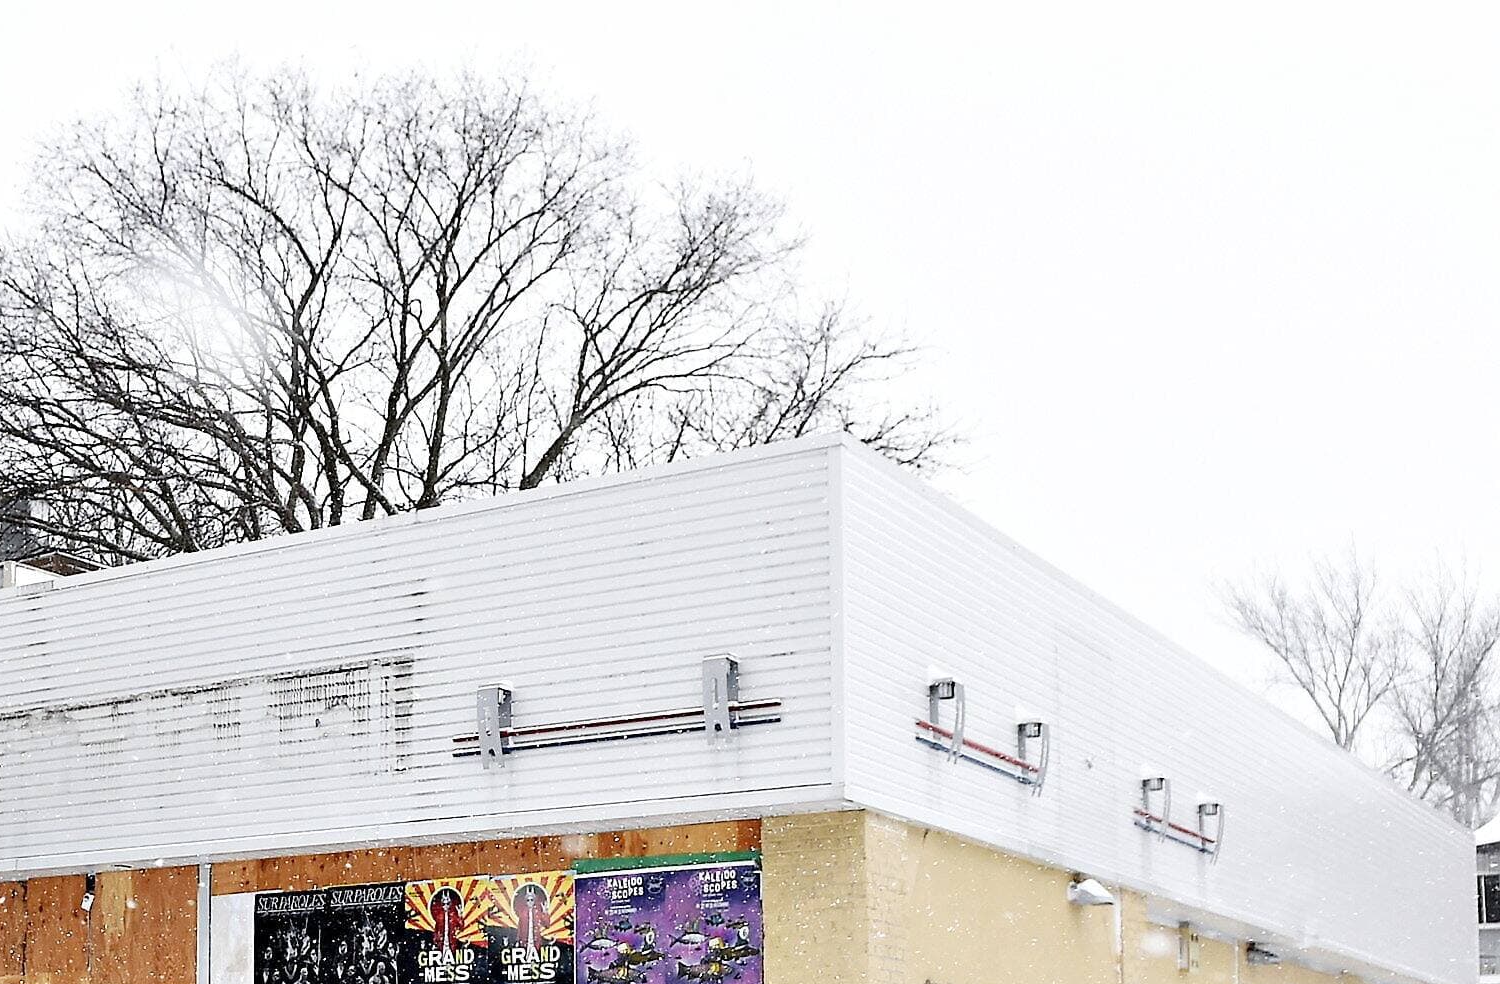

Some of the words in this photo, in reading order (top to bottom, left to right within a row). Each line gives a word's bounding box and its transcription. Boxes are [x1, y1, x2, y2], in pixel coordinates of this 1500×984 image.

[607, 876, 643, 890] KALEIDO
[698, 869, 737, 883] KALEIDO
[703, 879, 738, 893] SCOPES
[611, 887, 644, 900] SCOPES
[418, 949, 475, 967] GRAND
[501, 946, 561, 964] GRAND
